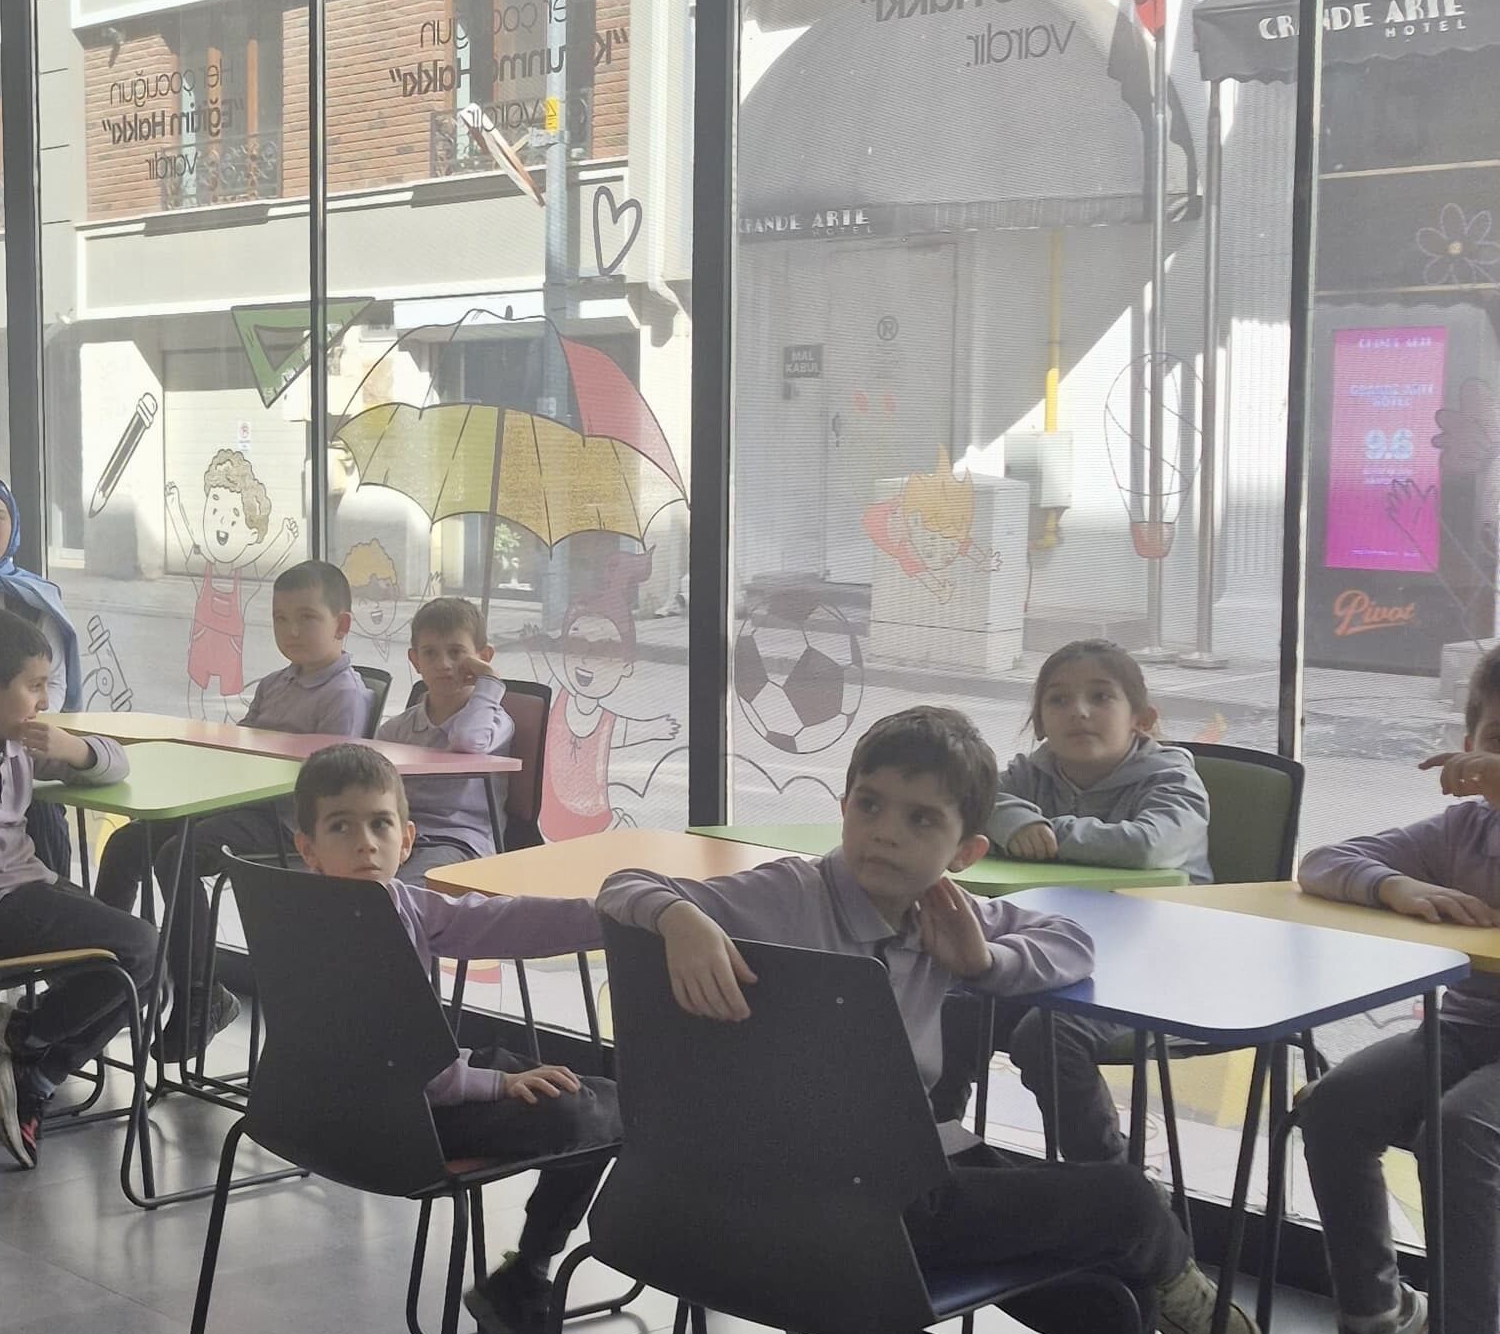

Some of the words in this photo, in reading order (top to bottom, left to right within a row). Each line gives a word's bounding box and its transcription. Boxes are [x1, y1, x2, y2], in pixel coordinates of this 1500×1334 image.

[1385, 18, 1467, 38] HOTEL
[791, 349, 815, 362] MAL
[1363, 427, 1414, 461] 9.6
[1333, 589, 1417, 636] Pivot
